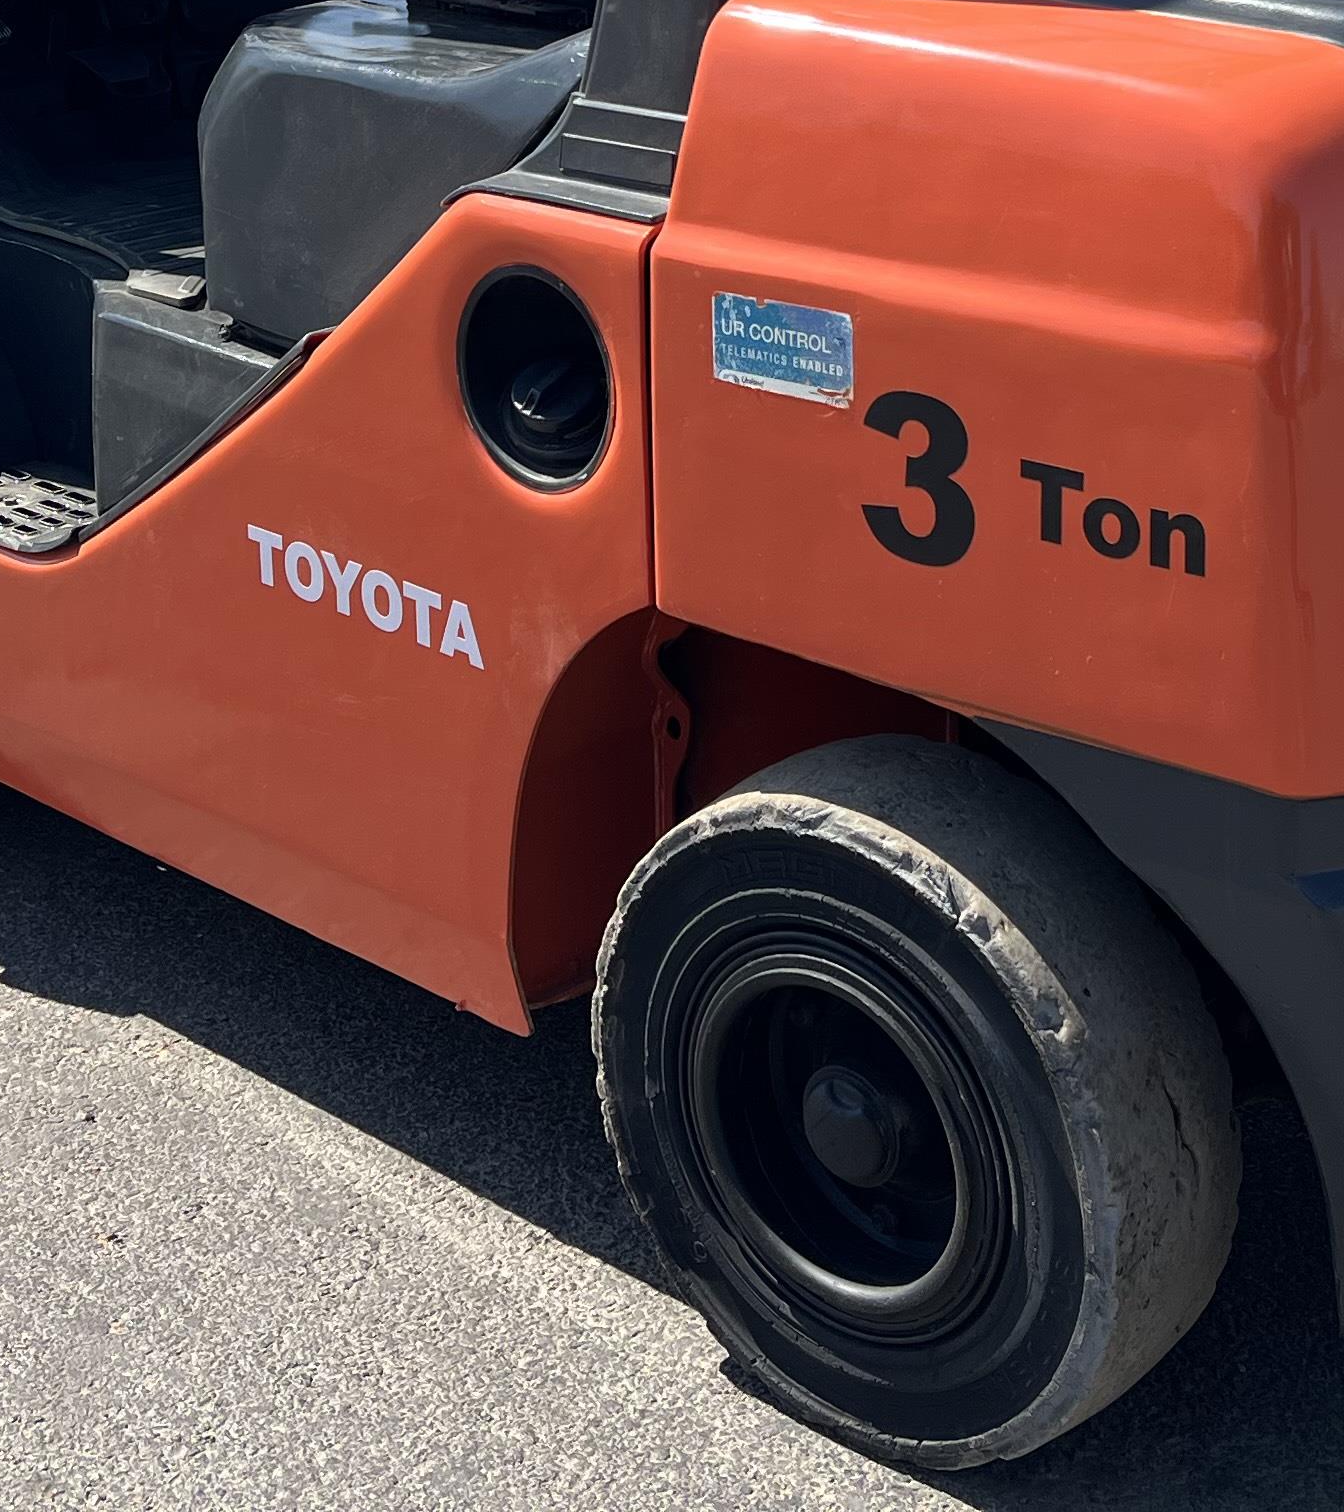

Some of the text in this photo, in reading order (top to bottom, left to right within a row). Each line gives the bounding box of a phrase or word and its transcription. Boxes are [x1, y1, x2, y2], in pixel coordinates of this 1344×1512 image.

[720, 343, 844, 377] TELEMATICS ENABLED
[721, 318, 832, 354] UR CONTROL
[861, 390, 1206, 577] 3 Ton
[248, 523, 485, 671] TOYOTA
